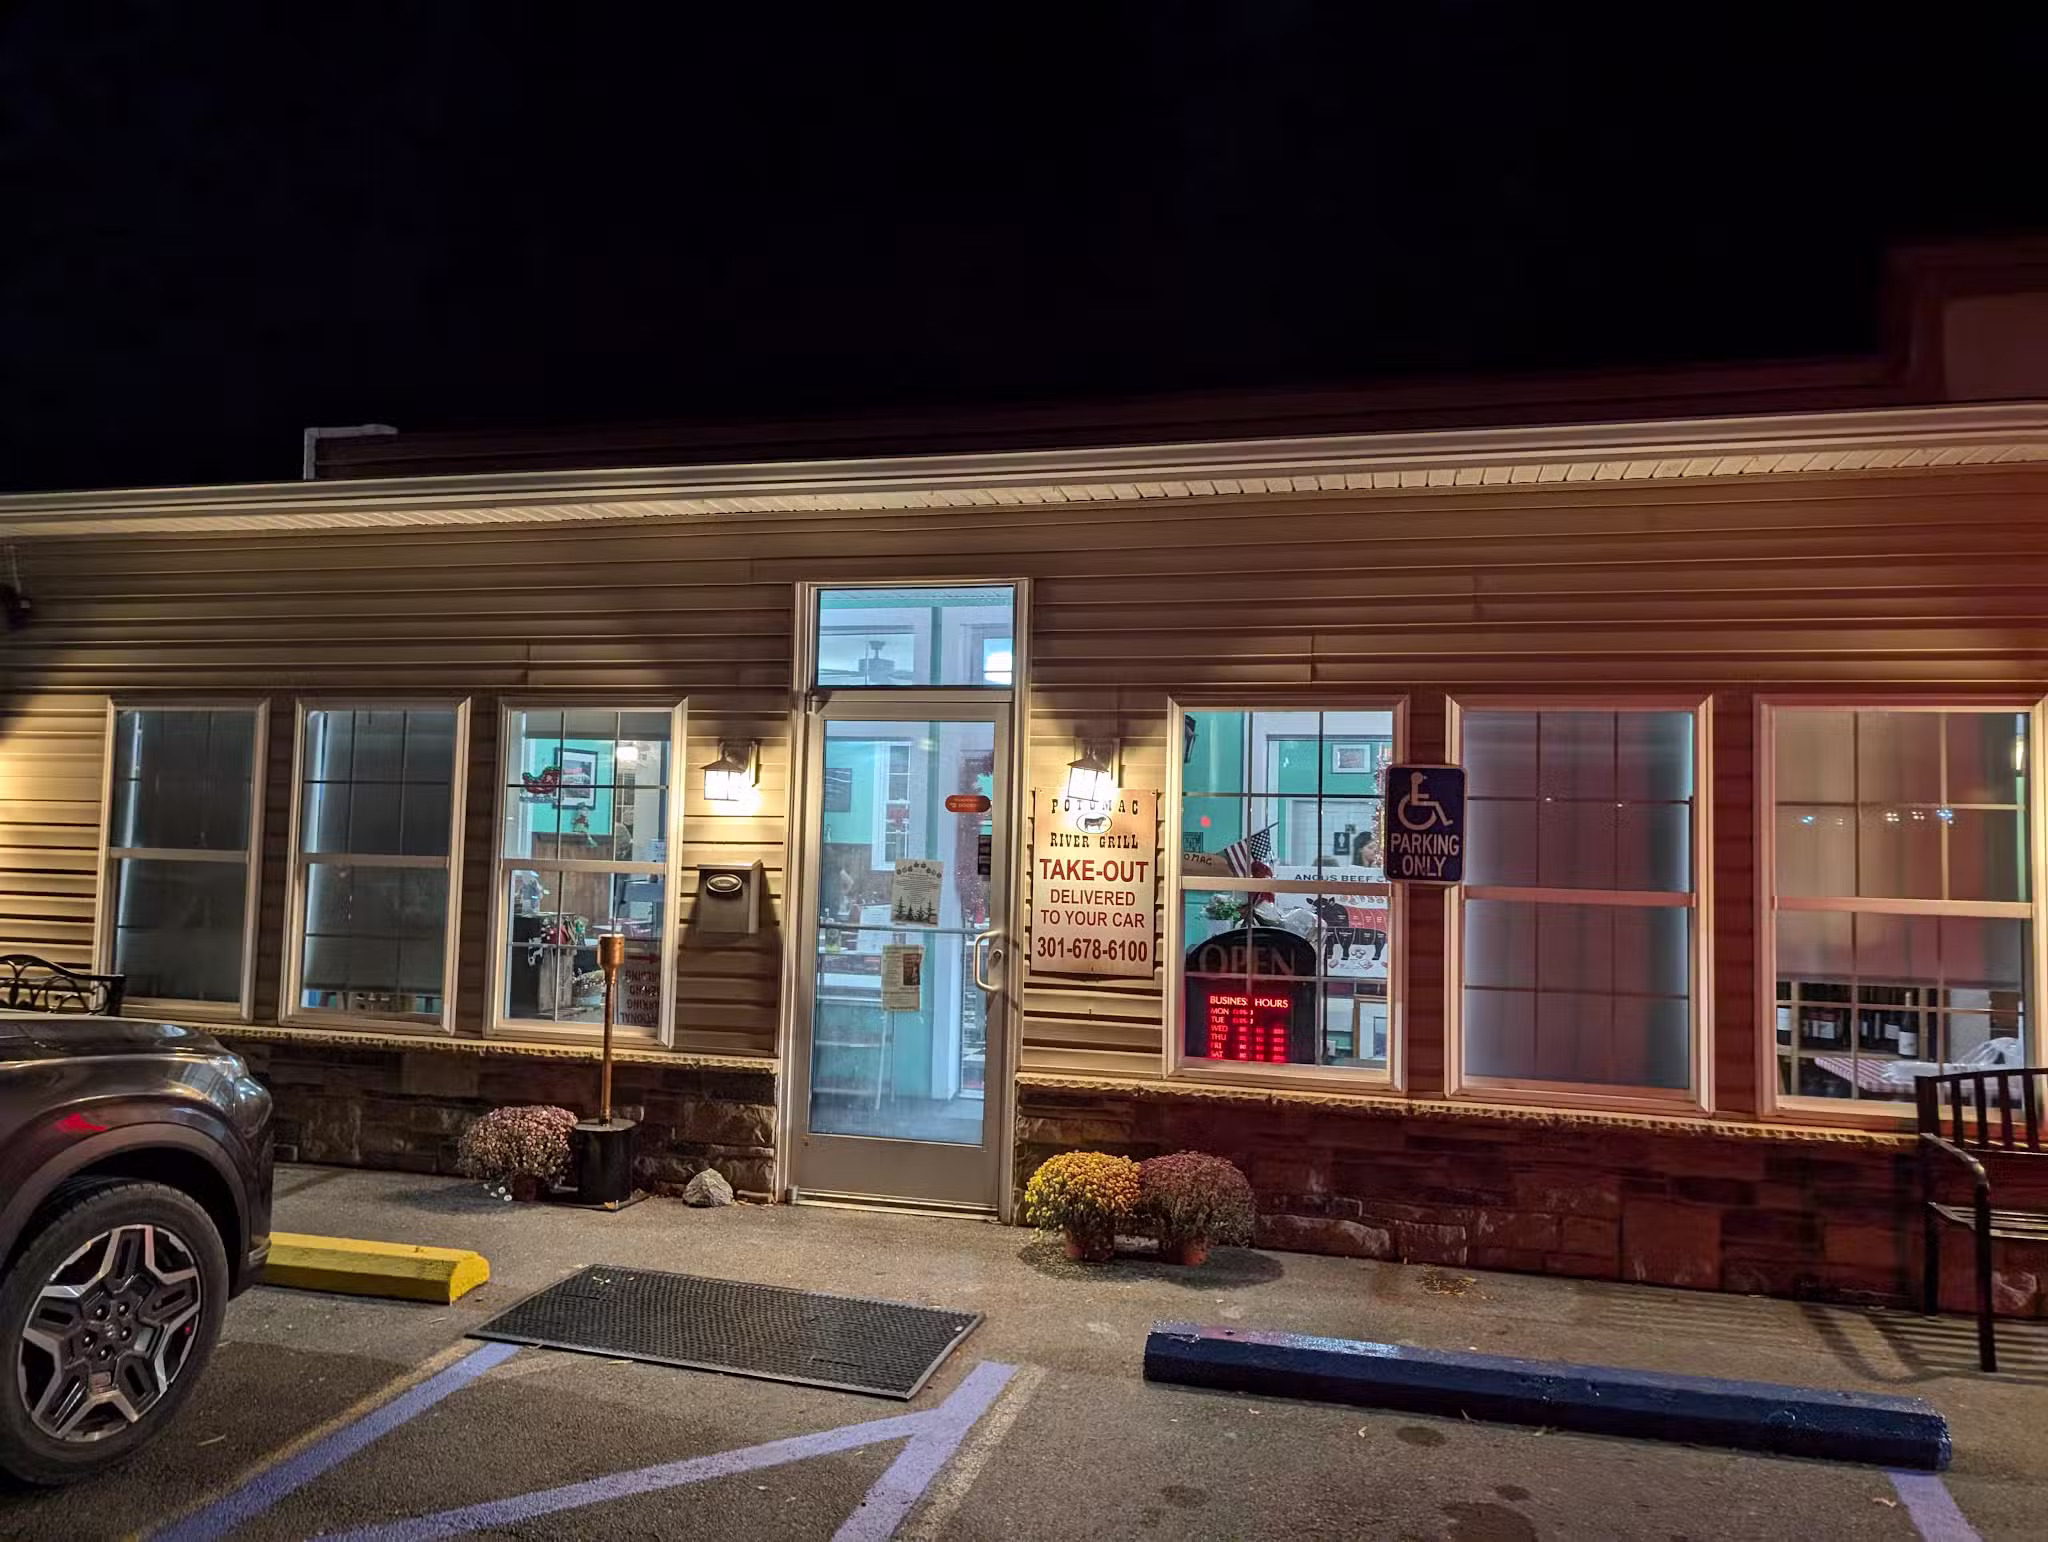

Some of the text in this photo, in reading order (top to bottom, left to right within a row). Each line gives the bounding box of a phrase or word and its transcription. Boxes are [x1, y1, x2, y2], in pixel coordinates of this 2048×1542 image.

[1051, 798, 1138, 815] POTOMAC
[1050, 832, 1138, 849] RIVER GRILL
[1391, 832, 1460, 856] PARKING
[1184, 853, 1212, 865] OMAC
[1402, 854, 1446, 877] ONLY
[1039, 858, 1149, 882] TAKE-OUT
[1050, 889, 1135, 906] DELIVERED
[1040, 910, 1145, 928] TO YOUR CAR
[1037, 937, 1148, 962] 301-678-6100
[1199, 944, 1295, 980] OPEN
[1209, 995, 1289, 1008] BUSINES HOURS
[1210, 1007, 1229, 1015] MON
[1211, 1033, 1227, 1041] THU
